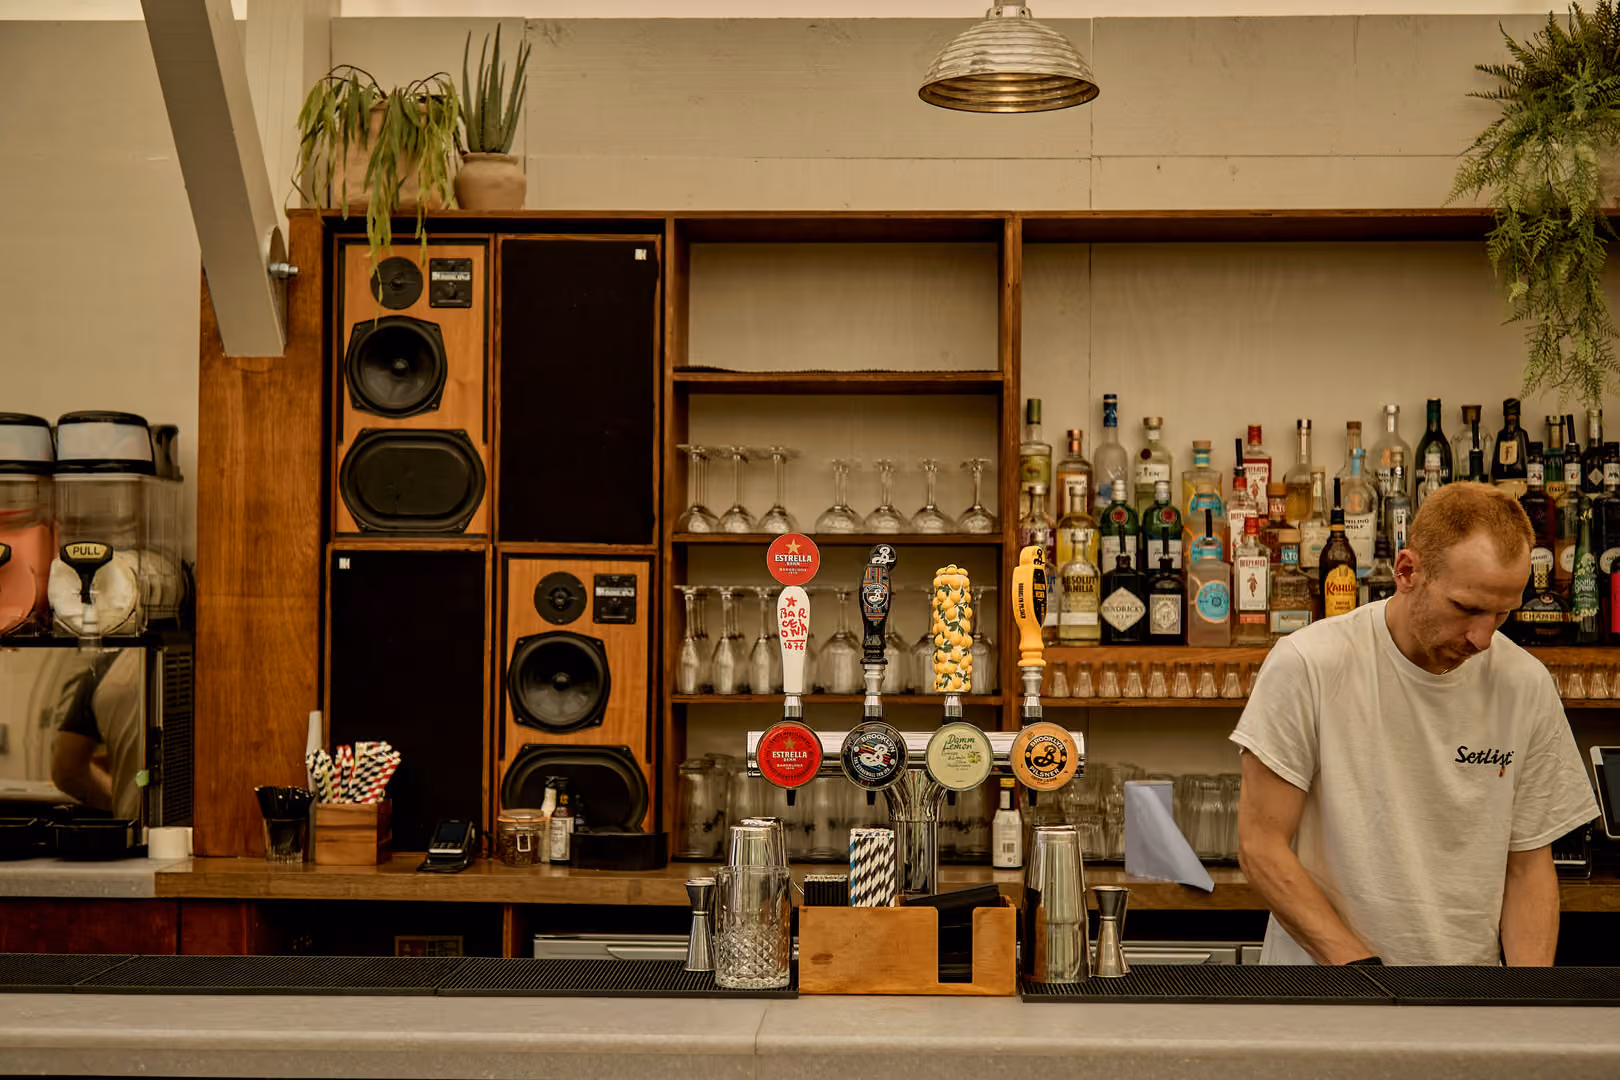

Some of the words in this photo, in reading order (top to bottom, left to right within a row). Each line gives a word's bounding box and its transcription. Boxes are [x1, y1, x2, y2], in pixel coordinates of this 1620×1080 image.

[72, 546, 100, 556] PULL
[774, 554, 812, 563] ESTRELLA
[861, 733, 897, 753] BROOKLYN
[1029, 735, 1065, 751] BROOKLYN
[772, 751, 808, 759] ESTRELLA
[1029, 765, 1060, 778] PILSNER
